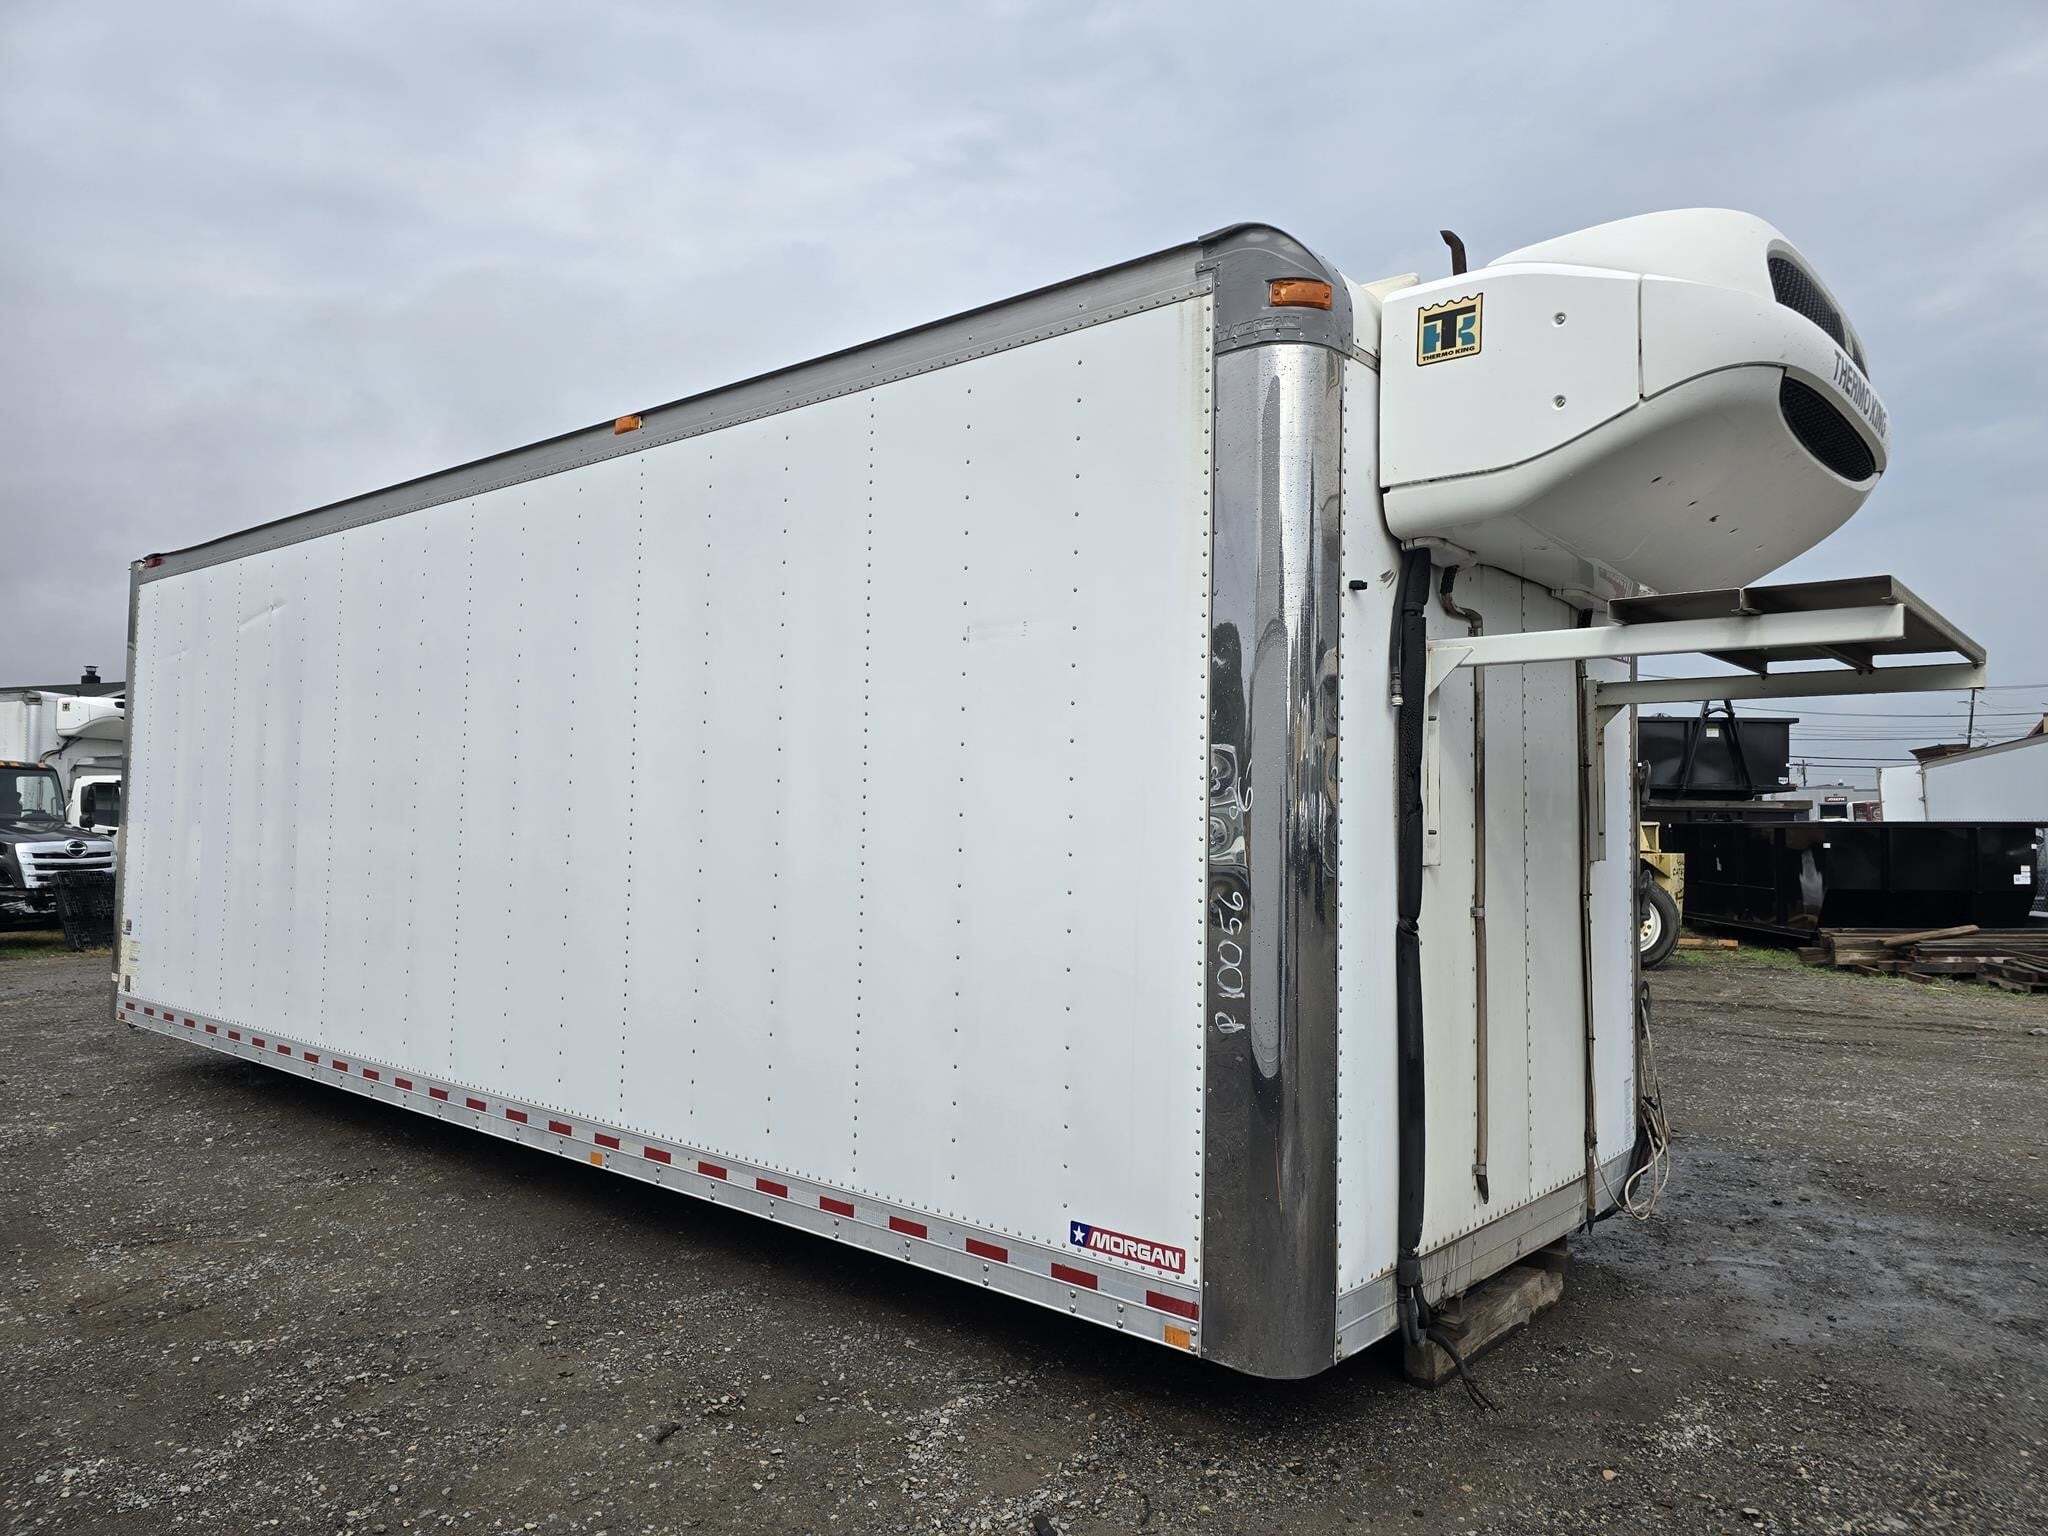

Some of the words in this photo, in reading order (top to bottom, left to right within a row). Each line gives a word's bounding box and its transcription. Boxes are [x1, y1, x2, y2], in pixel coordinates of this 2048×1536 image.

[1422, 350, 1454, 362] THERMO
[1455, 345, 1476, 356] KING
[1833, 348, 1871, 416] THERMO
[1869, 394, 1887, 439] KING
[1090, 1231, 1181, 1269] MORGAN
